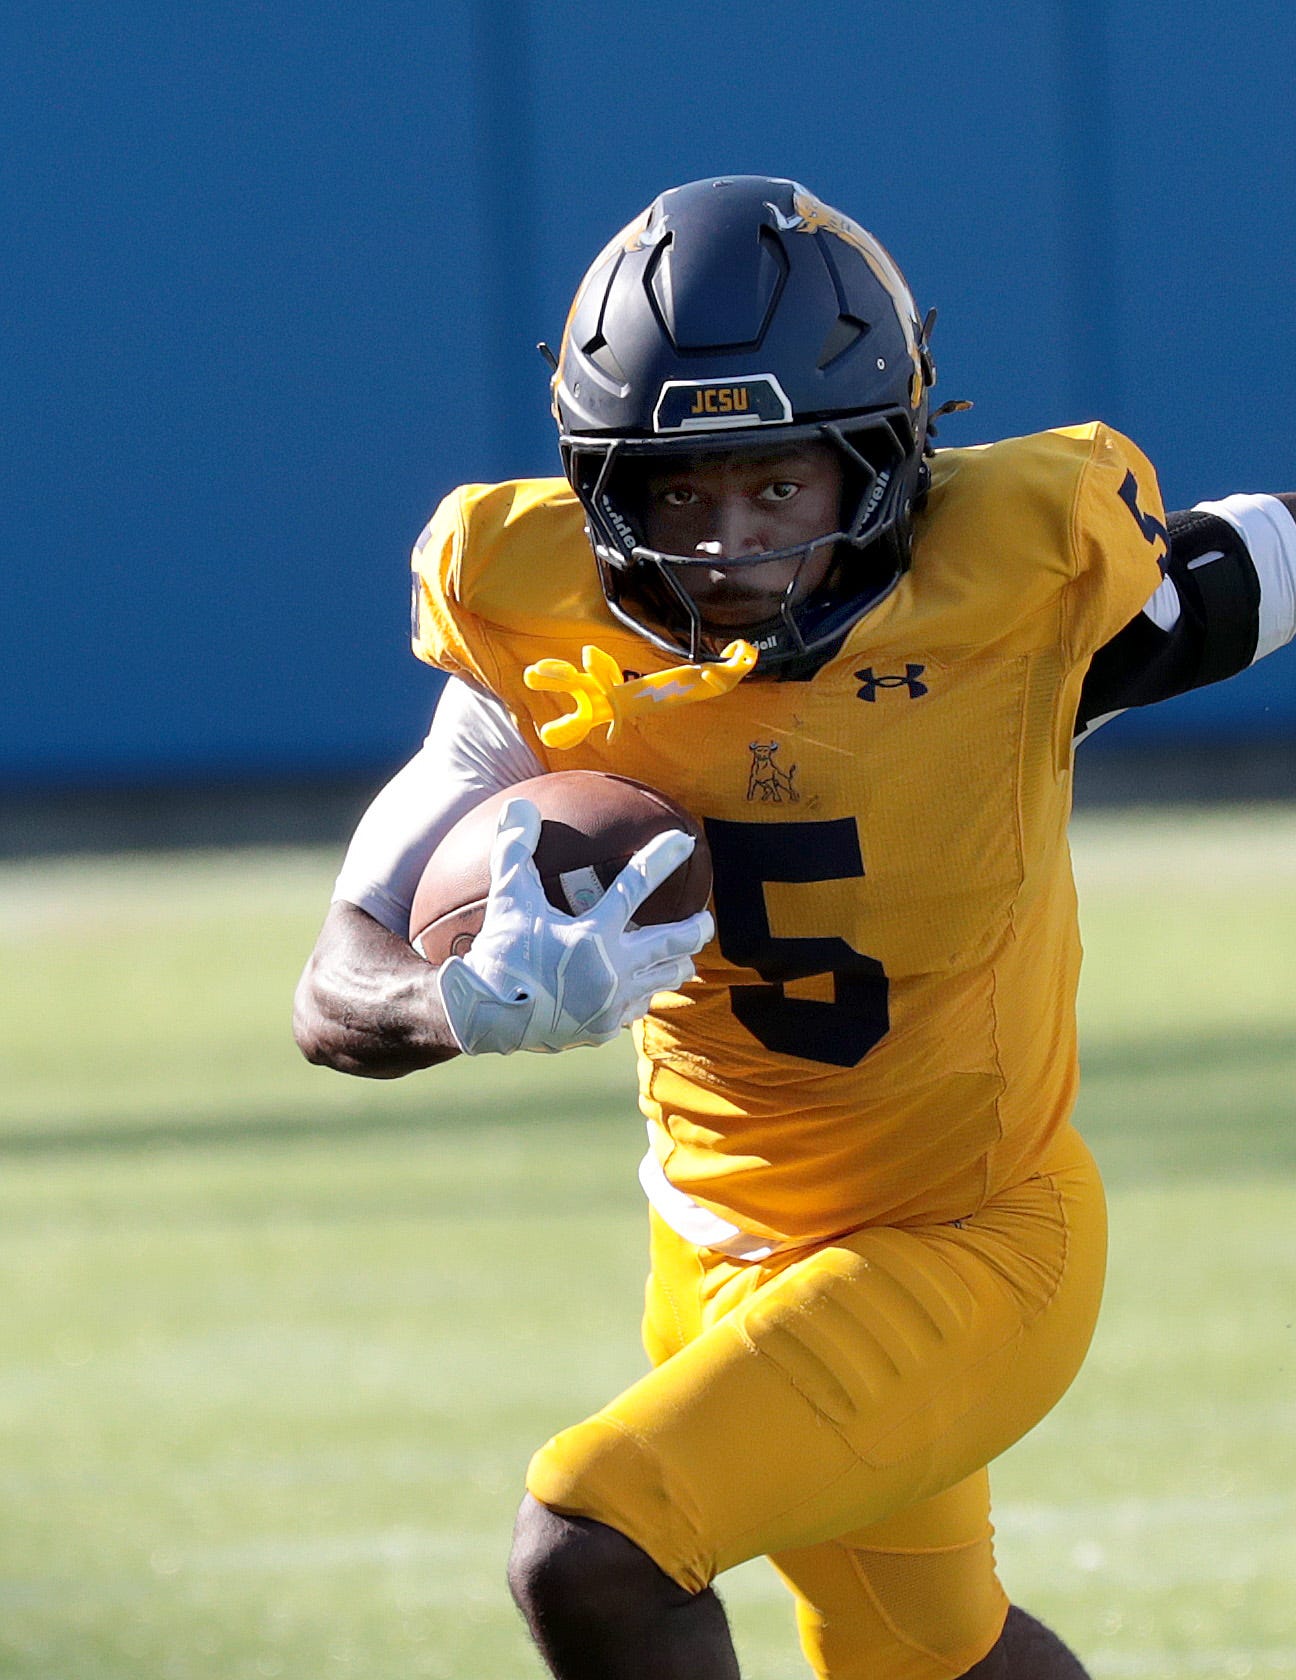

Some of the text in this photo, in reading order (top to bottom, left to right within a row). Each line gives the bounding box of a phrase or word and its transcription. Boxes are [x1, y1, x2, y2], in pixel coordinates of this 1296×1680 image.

[691, 387, 749, 414] JCSU
[1117, 468, 1172, 580] 5
[703, 816, 890, 1068] 5
